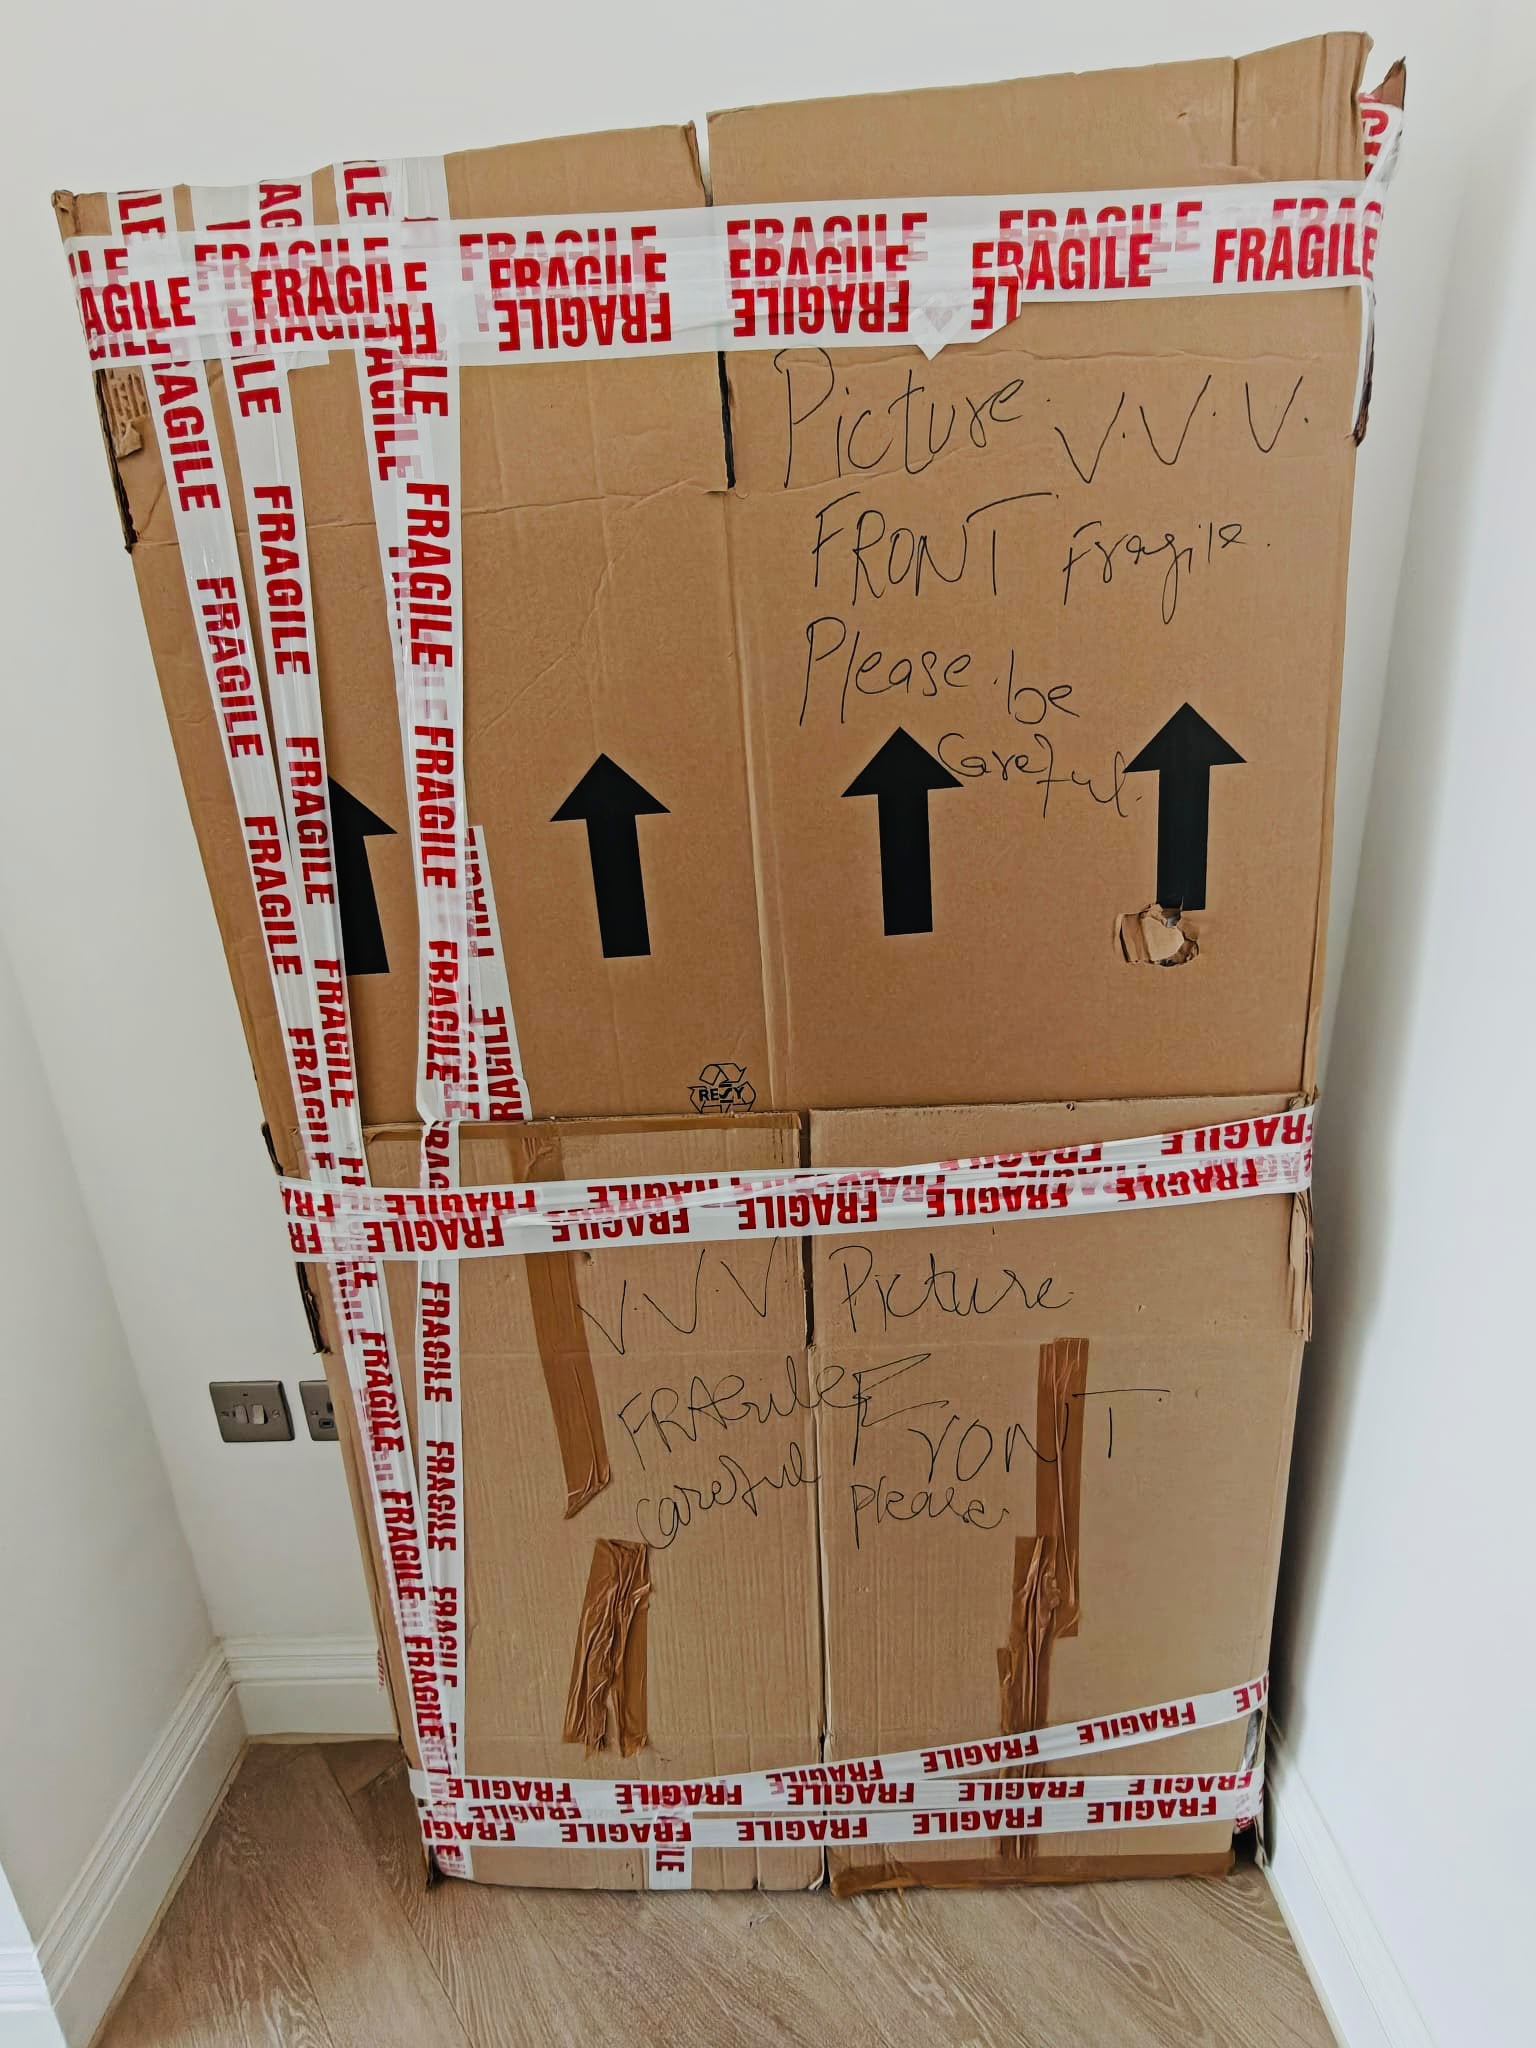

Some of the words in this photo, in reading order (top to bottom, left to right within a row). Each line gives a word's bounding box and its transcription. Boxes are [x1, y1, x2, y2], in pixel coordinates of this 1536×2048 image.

[1213, 223, 1378, 284] FRAGILE
[494, 292, 671, 351] FRAGILE
[731, 280, 909, 337] FRAGILE
[406, 482, 452, 667] FRAGILE
[197, 577, 264, 758] FRAGILE
[245, 816, 302, 975] FRAGILE
[254, 485, 311, 674] FRAGILE
[286, 736, 334, 905] FRAGILE
[314, 959, 355, 1108] FRAGILE
[415, 726, 456, 888] FRAGILE
[426, 940, 461, 1083] FRAGILE
[927, 1183, 1068, 1218] FRAGILE
[1117, 1158, 1260, 1201] FRAGILE
[739, 1191, 878, 1230] FRAGILE
[363, 1216, 504, 1252] FRAGILE
[421, 1281, 452, 1402] FRAGILE
[360, 1331, 405, 1453] FRAGILE
[426, 1440, 456, 1551] FRAGILE
[381, 1490, 426, 1600] FRAGILE
[404, 1635, 445, 1739] FRAGILE
[1077, 1702, 1196, 1745] FRAGILE
[766, 1759, 884, 1788] FRAGILE
[920, 1735, 1039, 1773] FRAGILE
[446, 1778, 572, 1803] FRAGILE
[615, 1783, 742, 1807] FRAGILE
[787, 1782, 915, 1806] FRAGILE
[958, 1781, 1085, 1801] FRAGILE
[1087, 1796, 1217, 1824] FRAGILE
[559, 1822, 692, 1843] FRAGILE
[736, 1817, 868, 1841] FRAGILE
[912, 1806, 1042, 1835] FRAGILE
